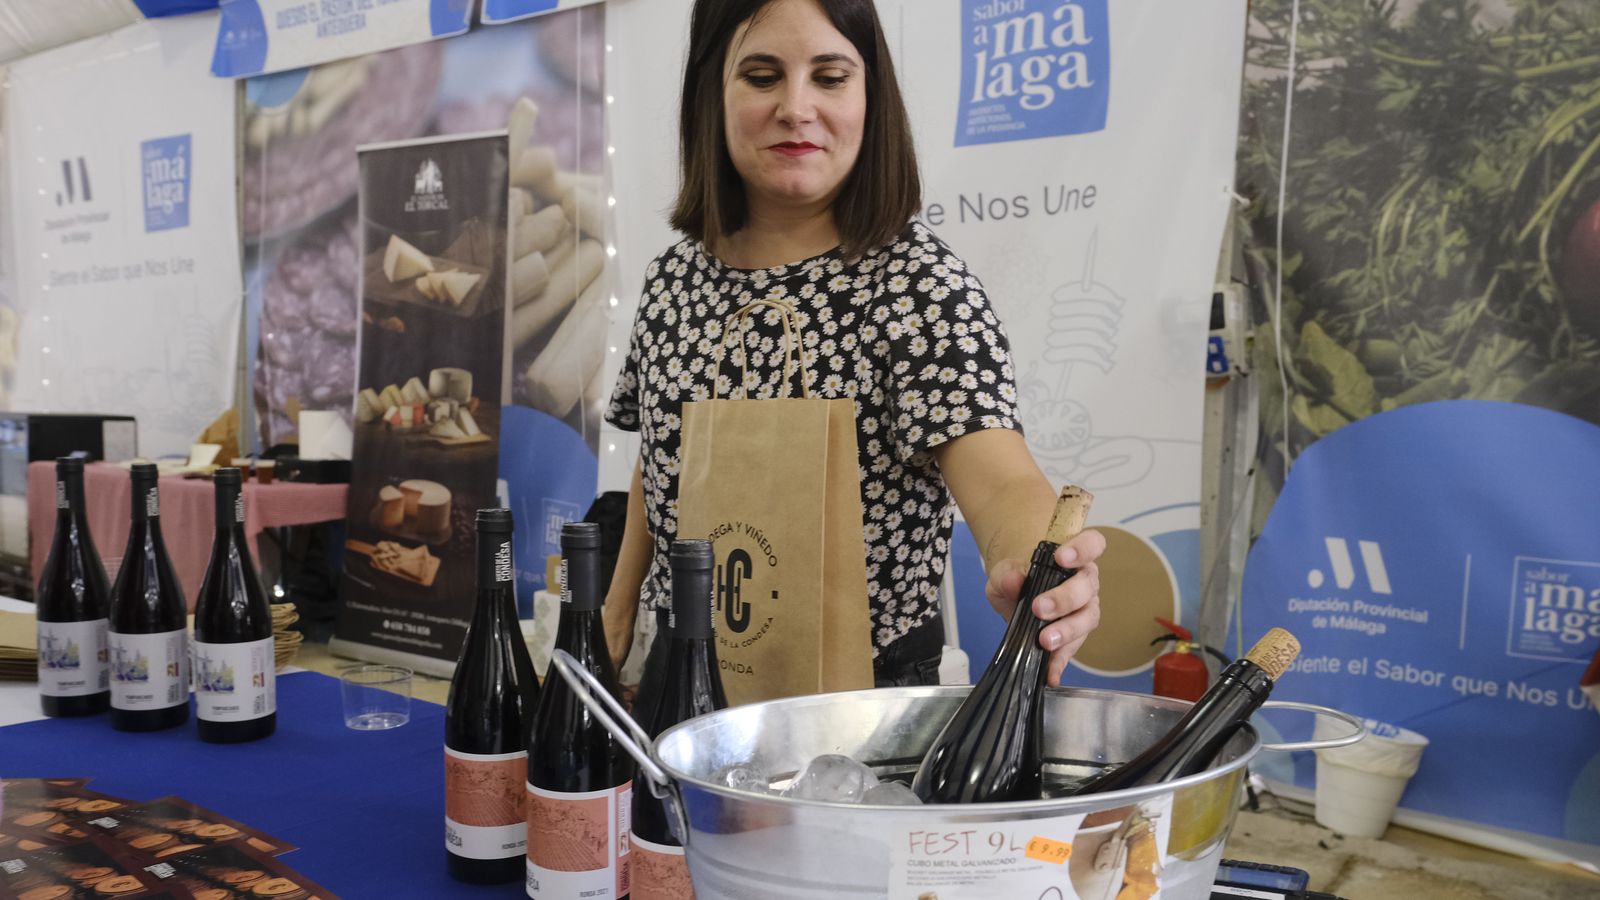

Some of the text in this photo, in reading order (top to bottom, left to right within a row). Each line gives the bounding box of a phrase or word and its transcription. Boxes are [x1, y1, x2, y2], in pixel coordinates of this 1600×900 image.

[972, 0, 1025, 21] sabor
[959, 192, 1030, 224] Nos
[1043, 184, 1098, 215] Une
[709, 522, 734, 544] DEGA
[745, 522, 778, 568] VIÑEDO
[500, 541, 511, 581] CONDESA
[1352, 600, 1429, 623] Provincial
[1312, 614, 1387, 636] de Málaga
[720, 659, 754, 675] ONDA
[1264, 643, 1297, 677] NDESA
[1347, 656, 1368, 675] el
[1375, 658, 1446, 688] Sabor
[1452, 674, 1499, 700] que
[1506, 680, 1558, 707] Nos
[909, 830, 977, 856] FEST
[907, 859, 931, 867] CUBO
[933, 859, 959, 867] METAL
